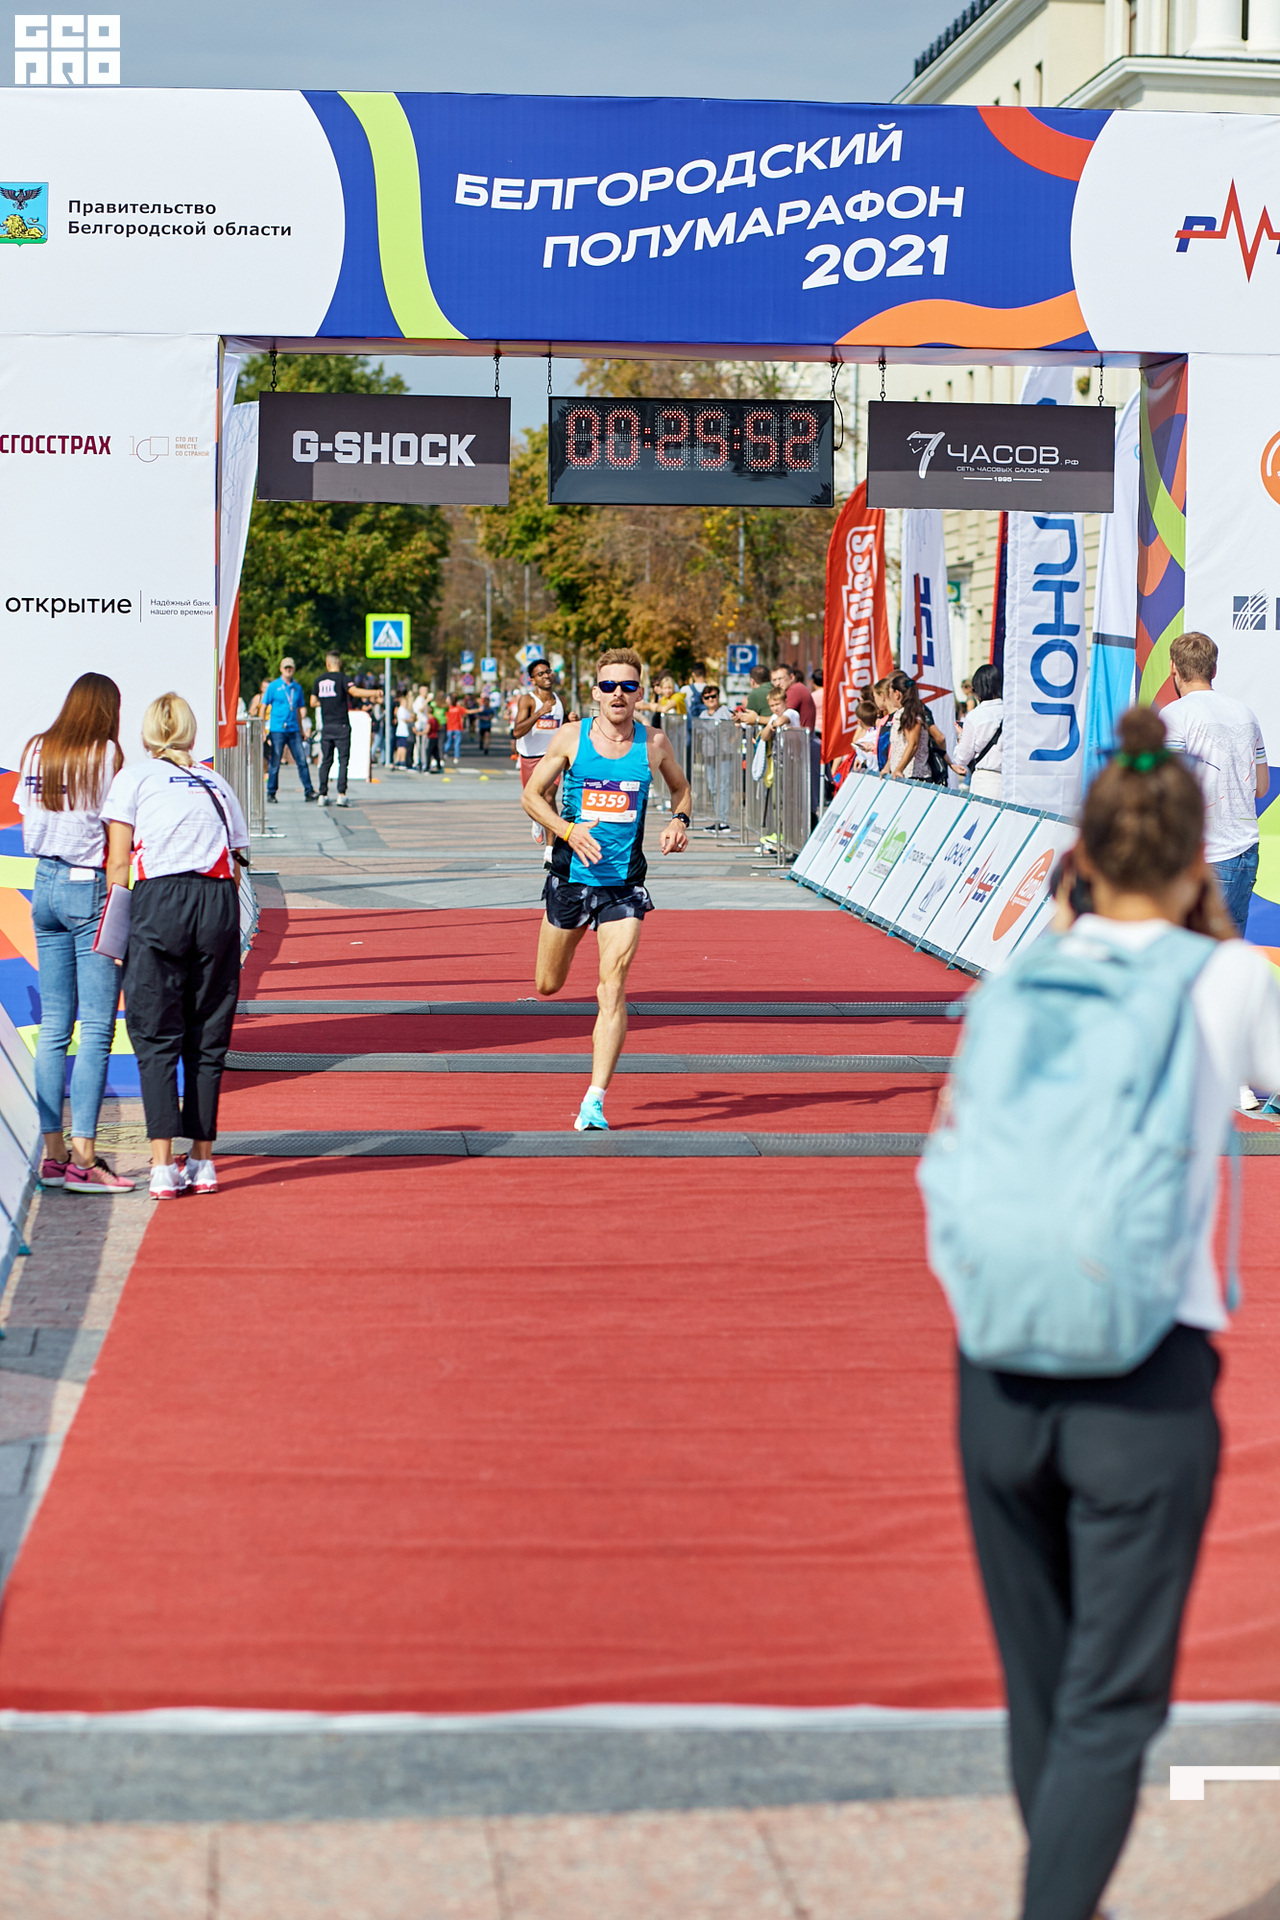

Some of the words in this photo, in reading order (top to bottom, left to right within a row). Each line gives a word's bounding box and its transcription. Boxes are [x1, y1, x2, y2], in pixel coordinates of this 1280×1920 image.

[455, 122, 903, 210] БЕЛГОРОДСКИЙ
[68, 200, 217, 216] Правительство
[68, 221, 207, 237] Белгородской
[213, 222, 292, 236] области
[543, 185, 965, 268] ПОЛУМАРАФОН
[802, 234, 948, 290] 2021
[0, 434, 111, 455] СГОССТРАХ
[292, 430, 476, 467] G-SHOCK
[566, 408, 817, 469] 00:25:52
[5, 597, 132, 618] открытие
[150, 598, 190, 607] Надёжный
[192, 598, 211, 607] банк
[150, 608, 179, 616] нашего
[585, 792, 628, 809] 5359
